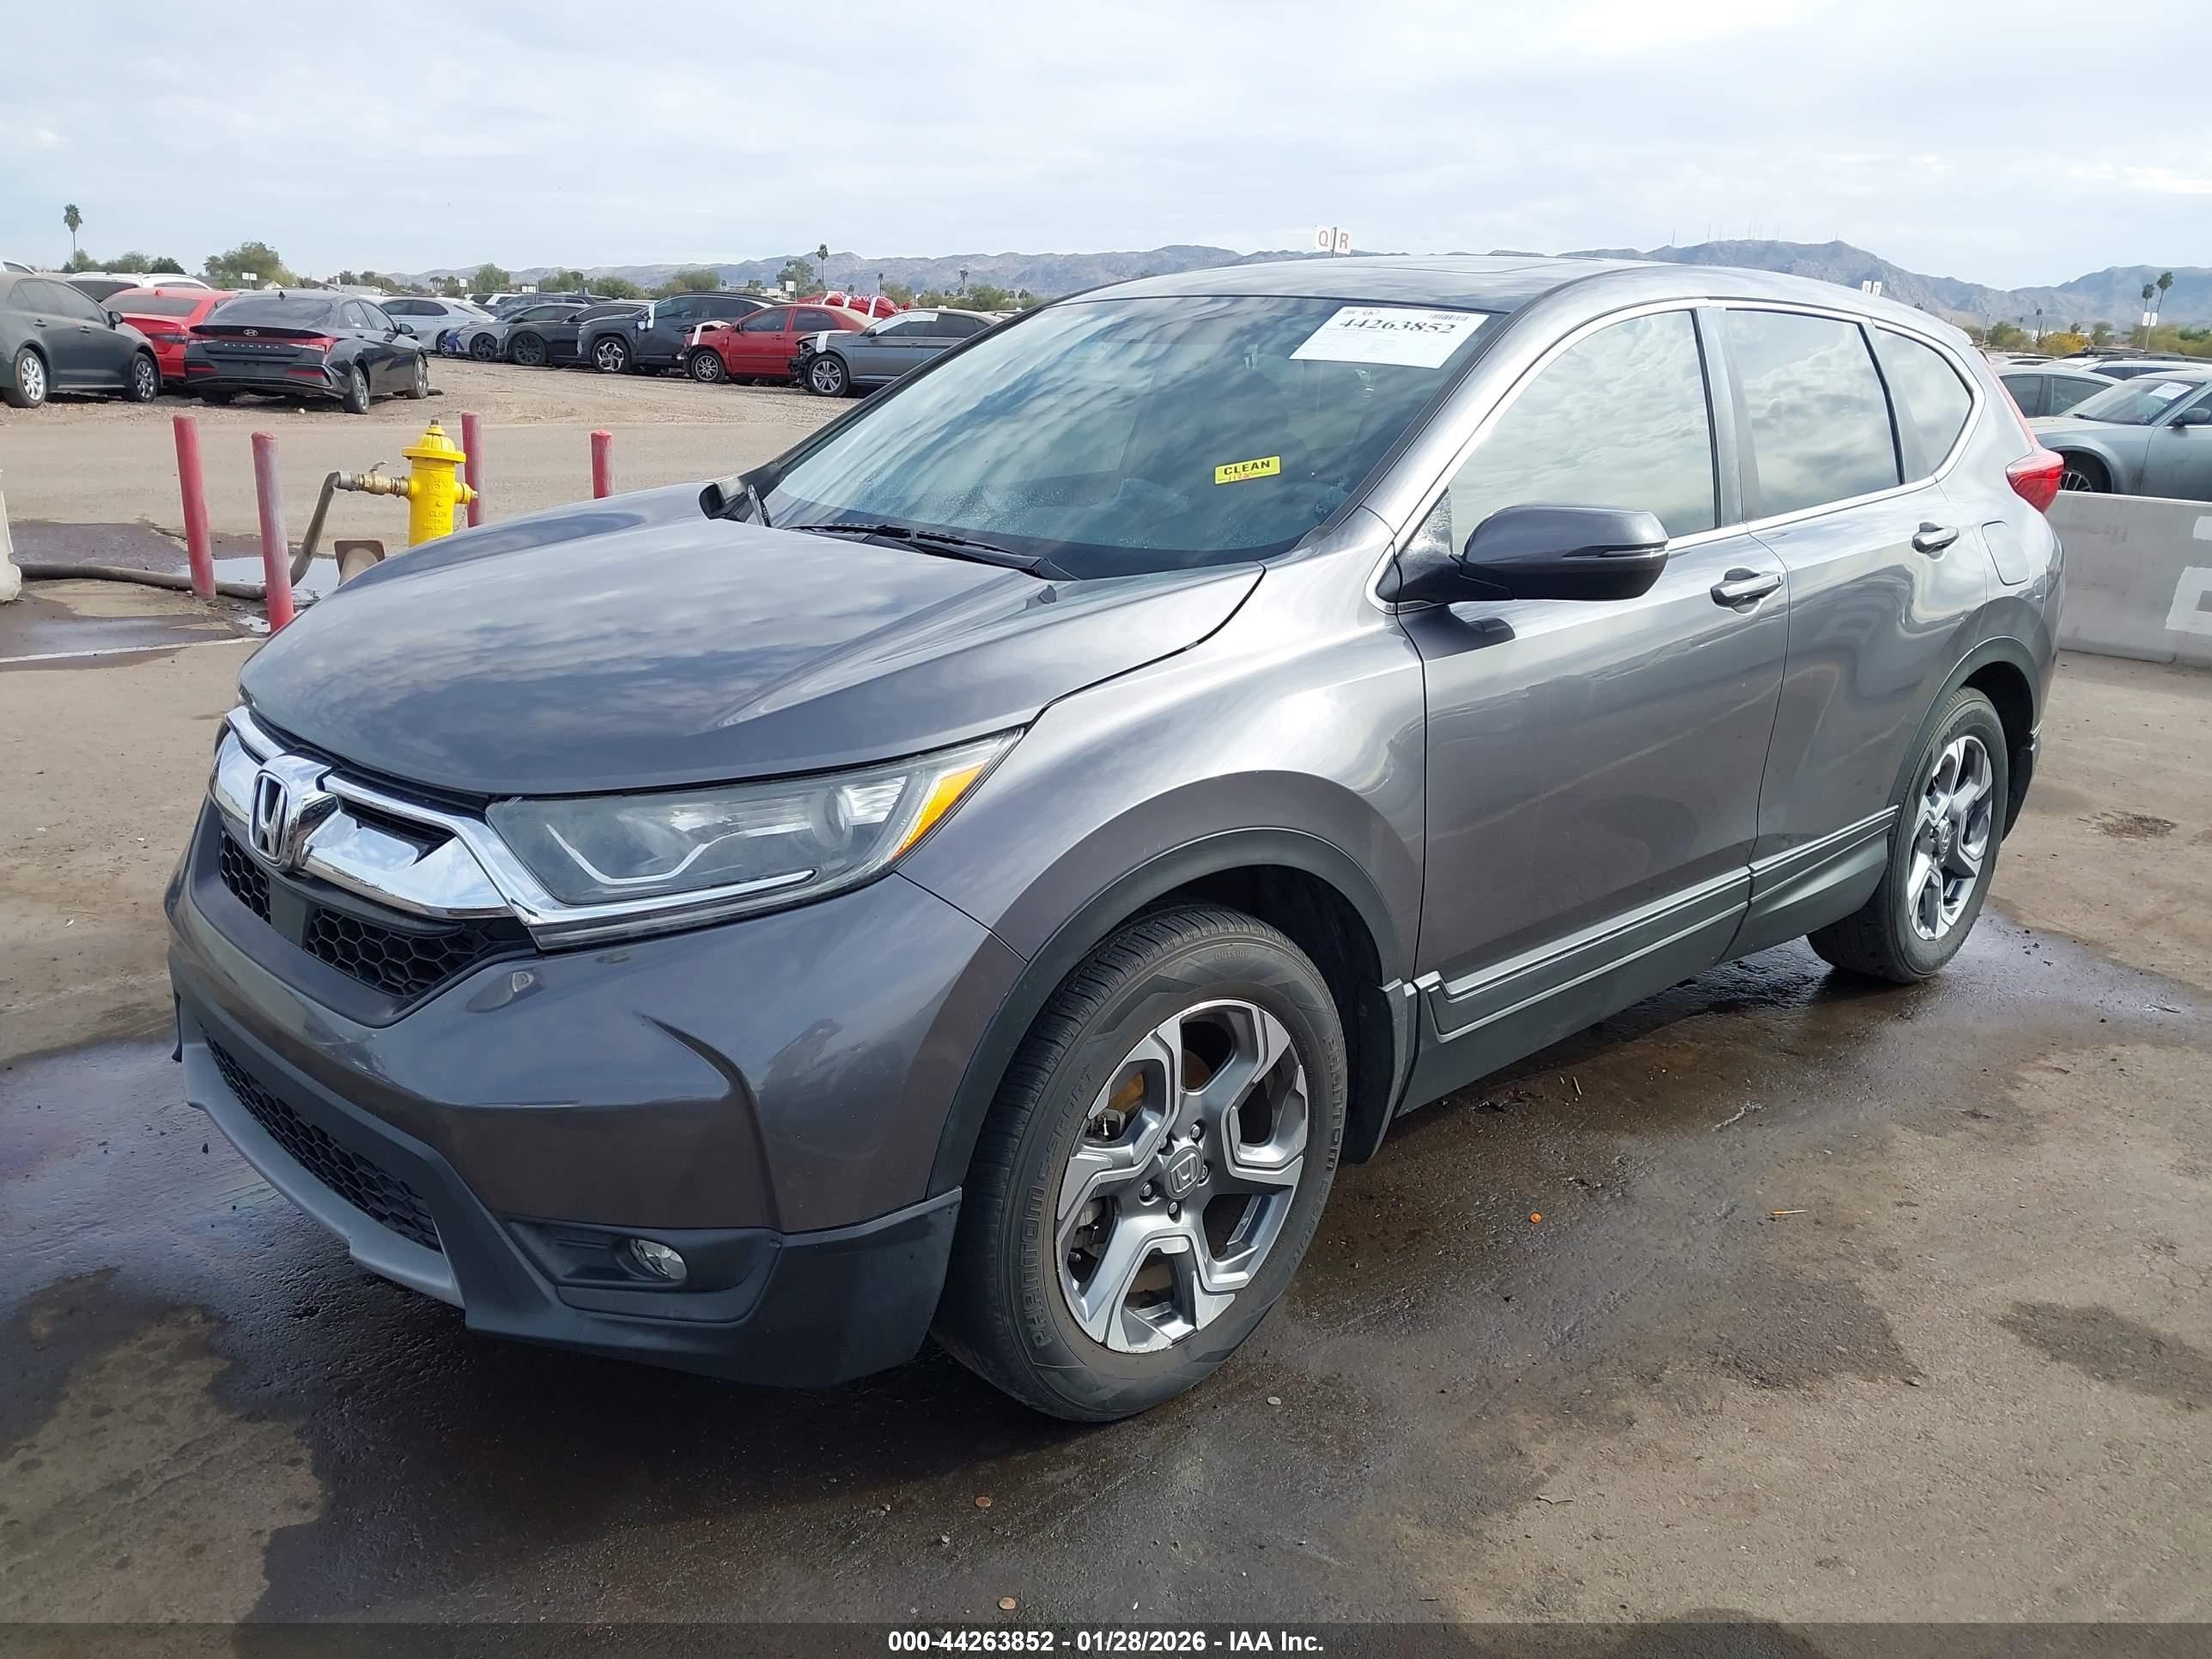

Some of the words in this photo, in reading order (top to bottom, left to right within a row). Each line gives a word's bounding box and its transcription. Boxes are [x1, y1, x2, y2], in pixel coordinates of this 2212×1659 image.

[1318, 229, 1329, 247] Q
[1339, 232, 1349, 249] R
[1339, 318, 1456, 334] 44263852
[1224, 459, 1271, 476] CLEAN
[1215, 949, 1251, 961] OUTSIDE
[1019, 1187, 1054, 1352] PHANTOM
